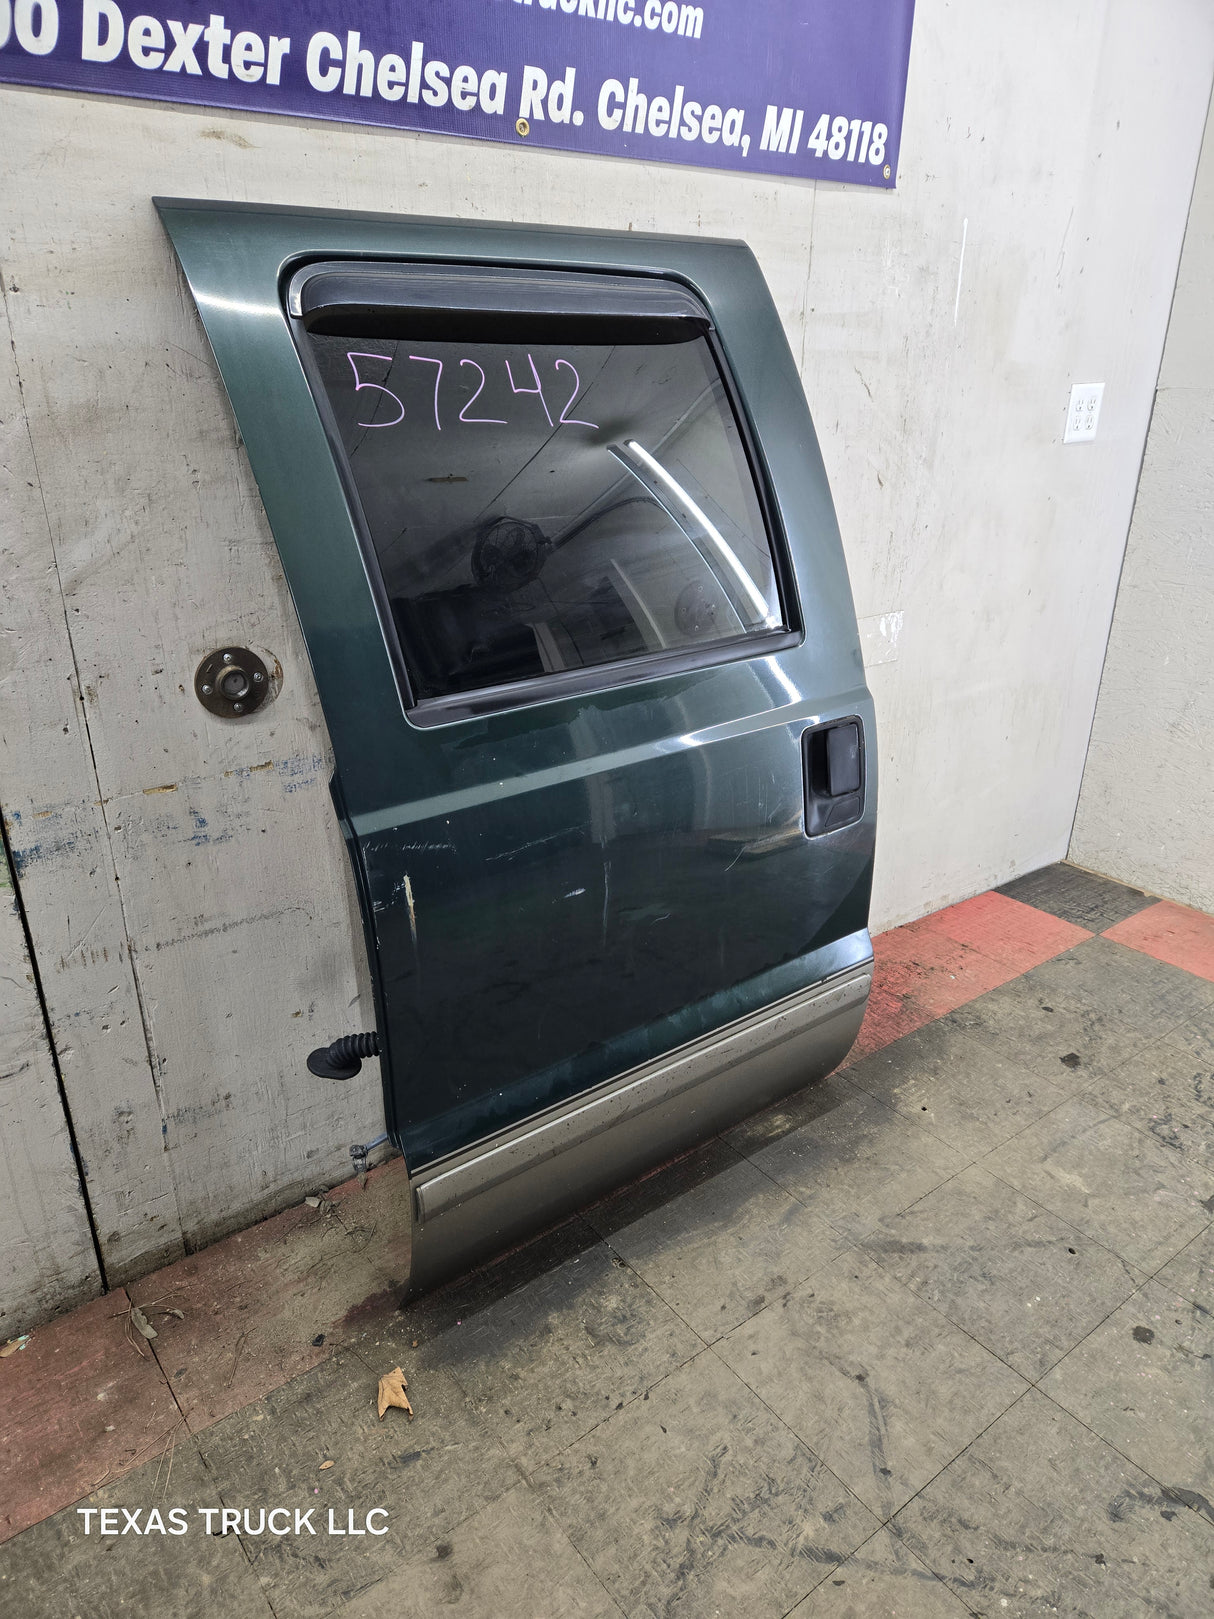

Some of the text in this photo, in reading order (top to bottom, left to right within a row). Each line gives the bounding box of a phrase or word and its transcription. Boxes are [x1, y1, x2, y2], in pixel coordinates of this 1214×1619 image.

[0, 0, 889, 166] 0 Dexter Chelsea Rd. Chelsea, MI 48118
[347, 352, 599, 430] 57242
